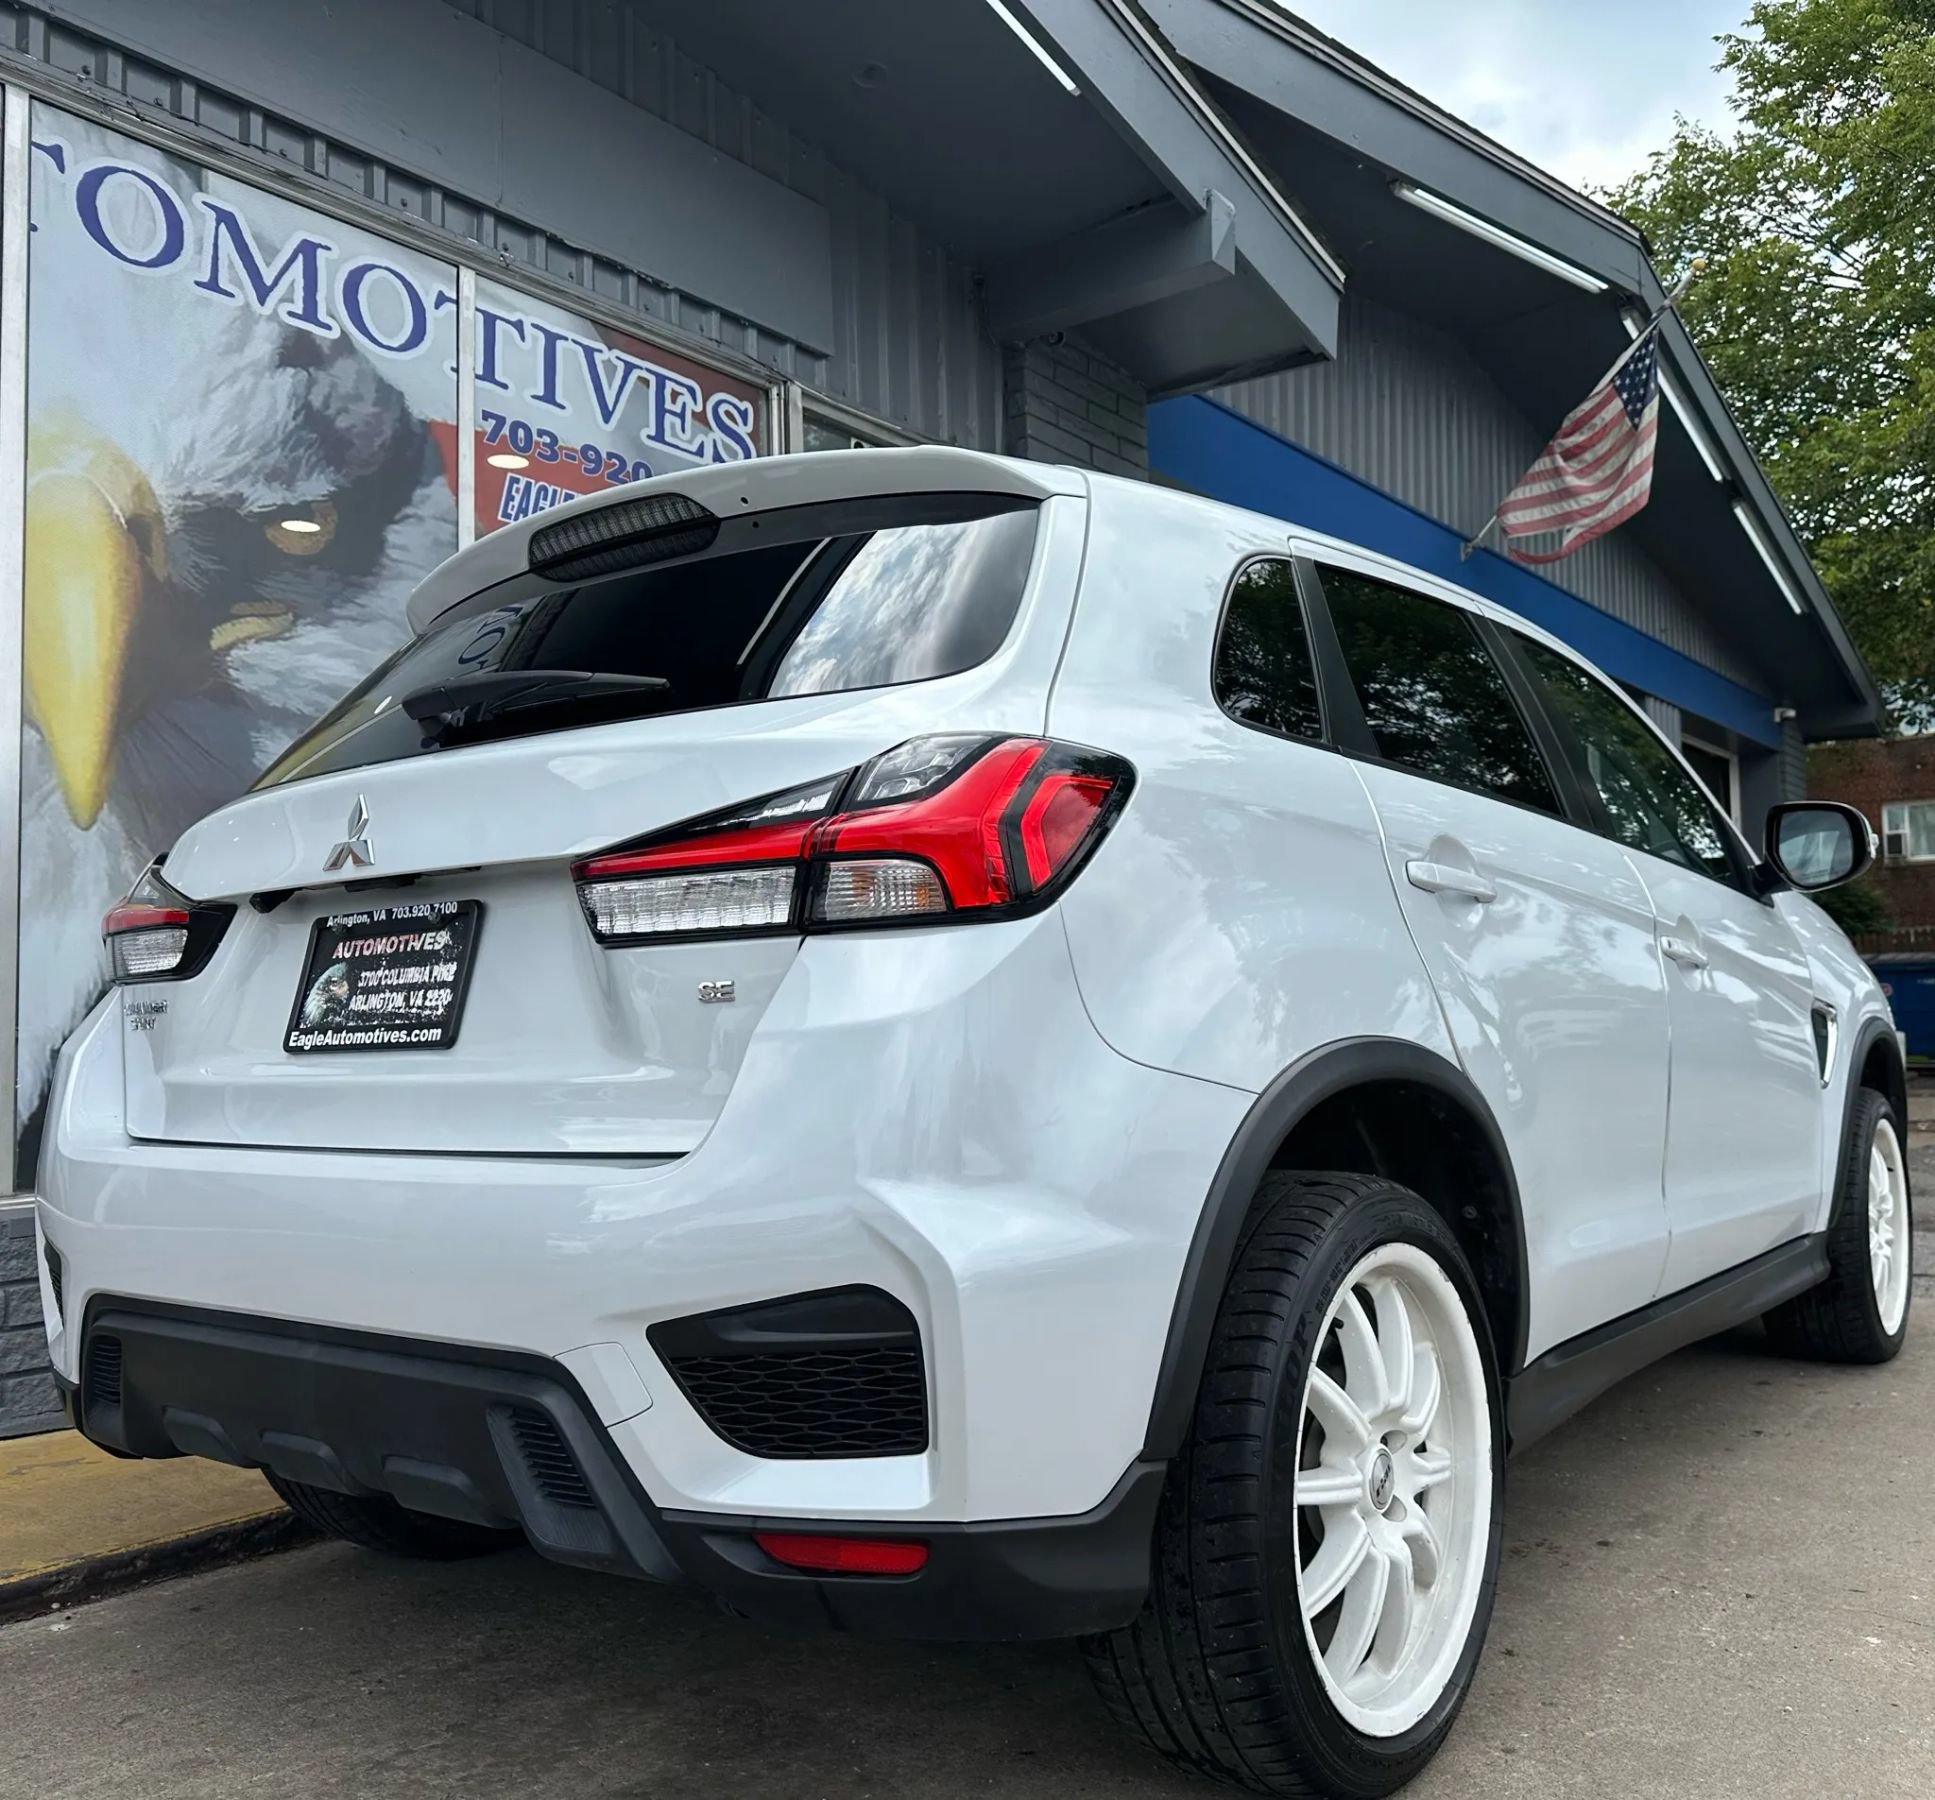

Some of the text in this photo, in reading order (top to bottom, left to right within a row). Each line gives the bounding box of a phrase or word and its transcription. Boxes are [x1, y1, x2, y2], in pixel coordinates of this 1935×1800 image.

[327, 901, 458, 928] Arlington, VA 703.9207100
[698, 980, 735, 1004] SE
[289, 1028, 442, 1050] EagleAutomotives.com
